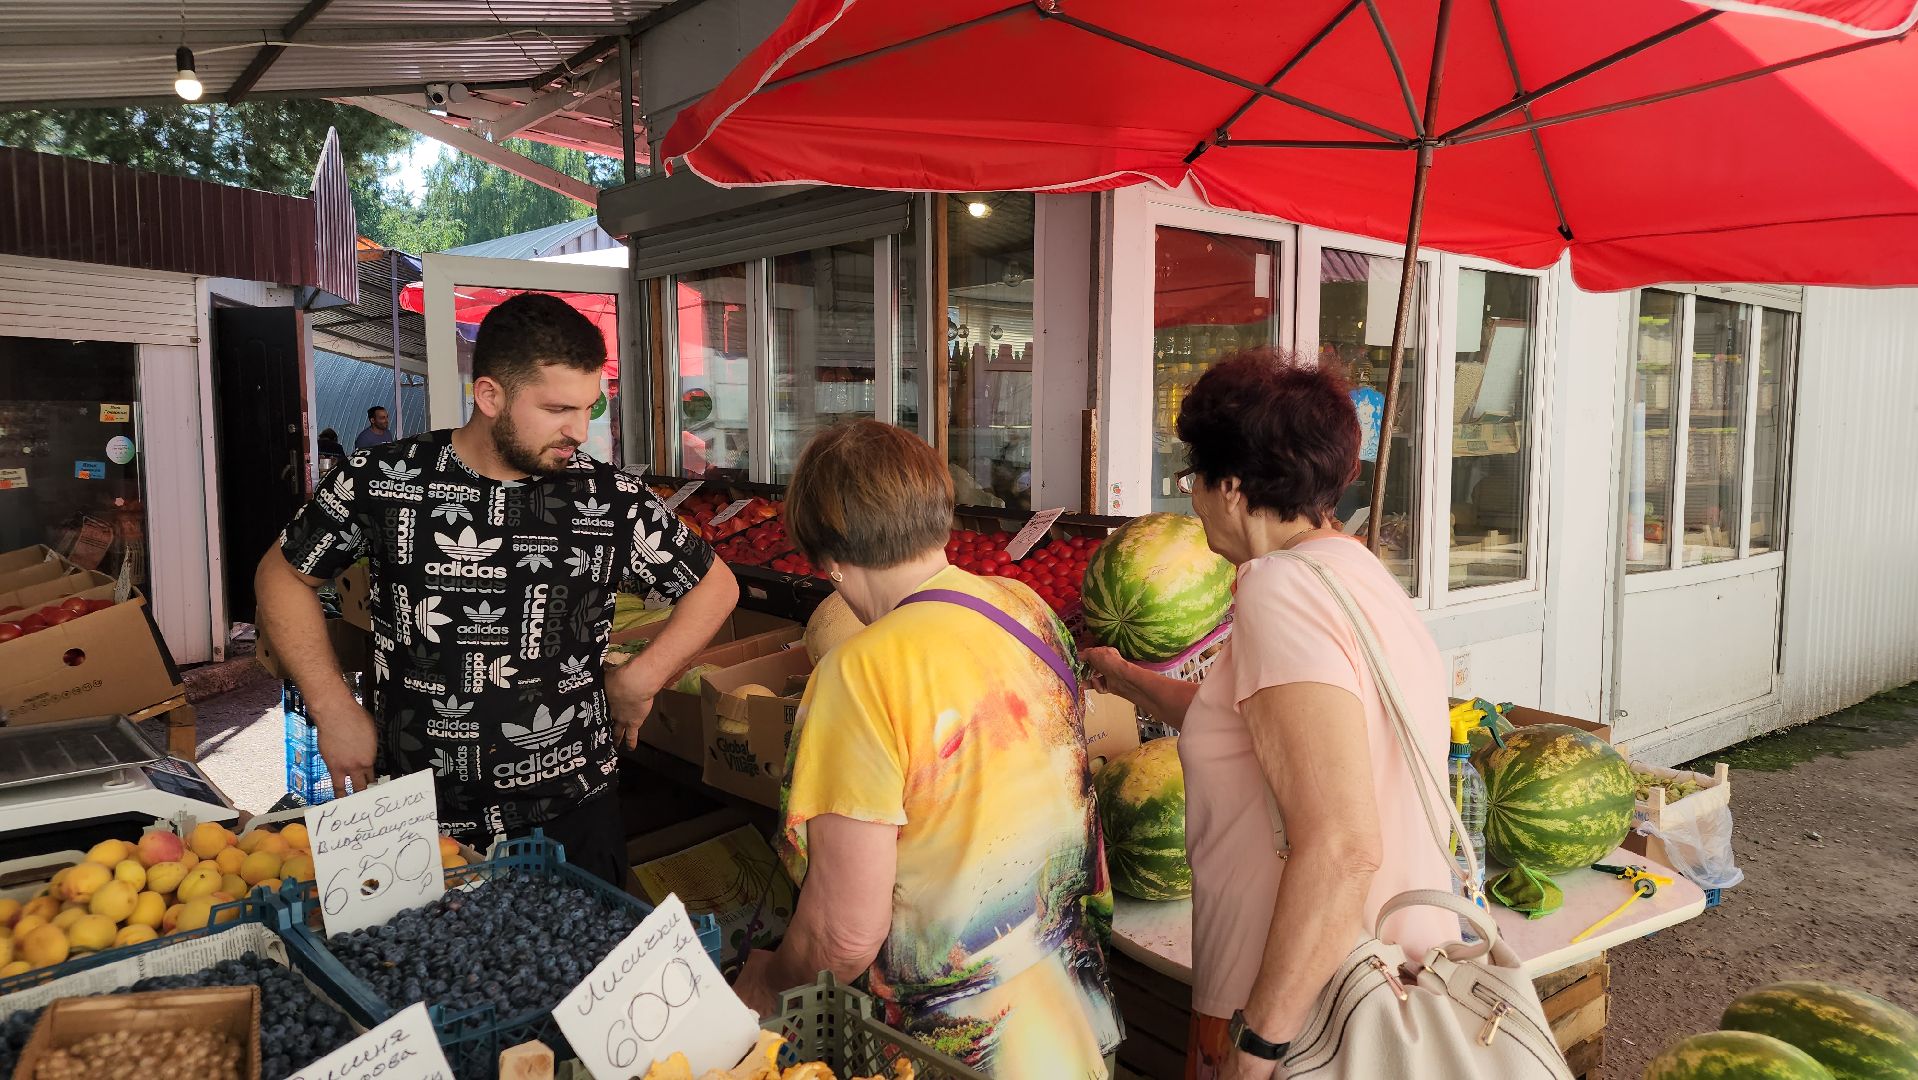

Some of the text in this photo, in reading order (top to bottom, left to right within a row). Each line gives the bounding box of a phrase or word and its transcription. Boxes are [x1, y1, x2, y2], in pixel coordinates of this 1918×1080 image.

[369, 480, 425, 494] adidas
[428, 490, 481, 502] adidas
[320, 488, 349, 518] adidas
[572, 518, 614, 528] adidas
[512, 544, 558, 553] adidas
[425, 561, 507, 578] adidas
[592, 545, 604, 582] adidas
[673, 567, 693, 590] adidas
[398, 585, 411, 645] adidas
[544, 585, 569, 657] adidas
[457, 624, 509, 634] adidas
[473, 652, 487, 693] adidas
[592, 691, 602, 725] adidas
[427, 719, 479, 731] adidas
[456, 746, 468, 782] adidas
[493, 741, 583, 777] adidas
